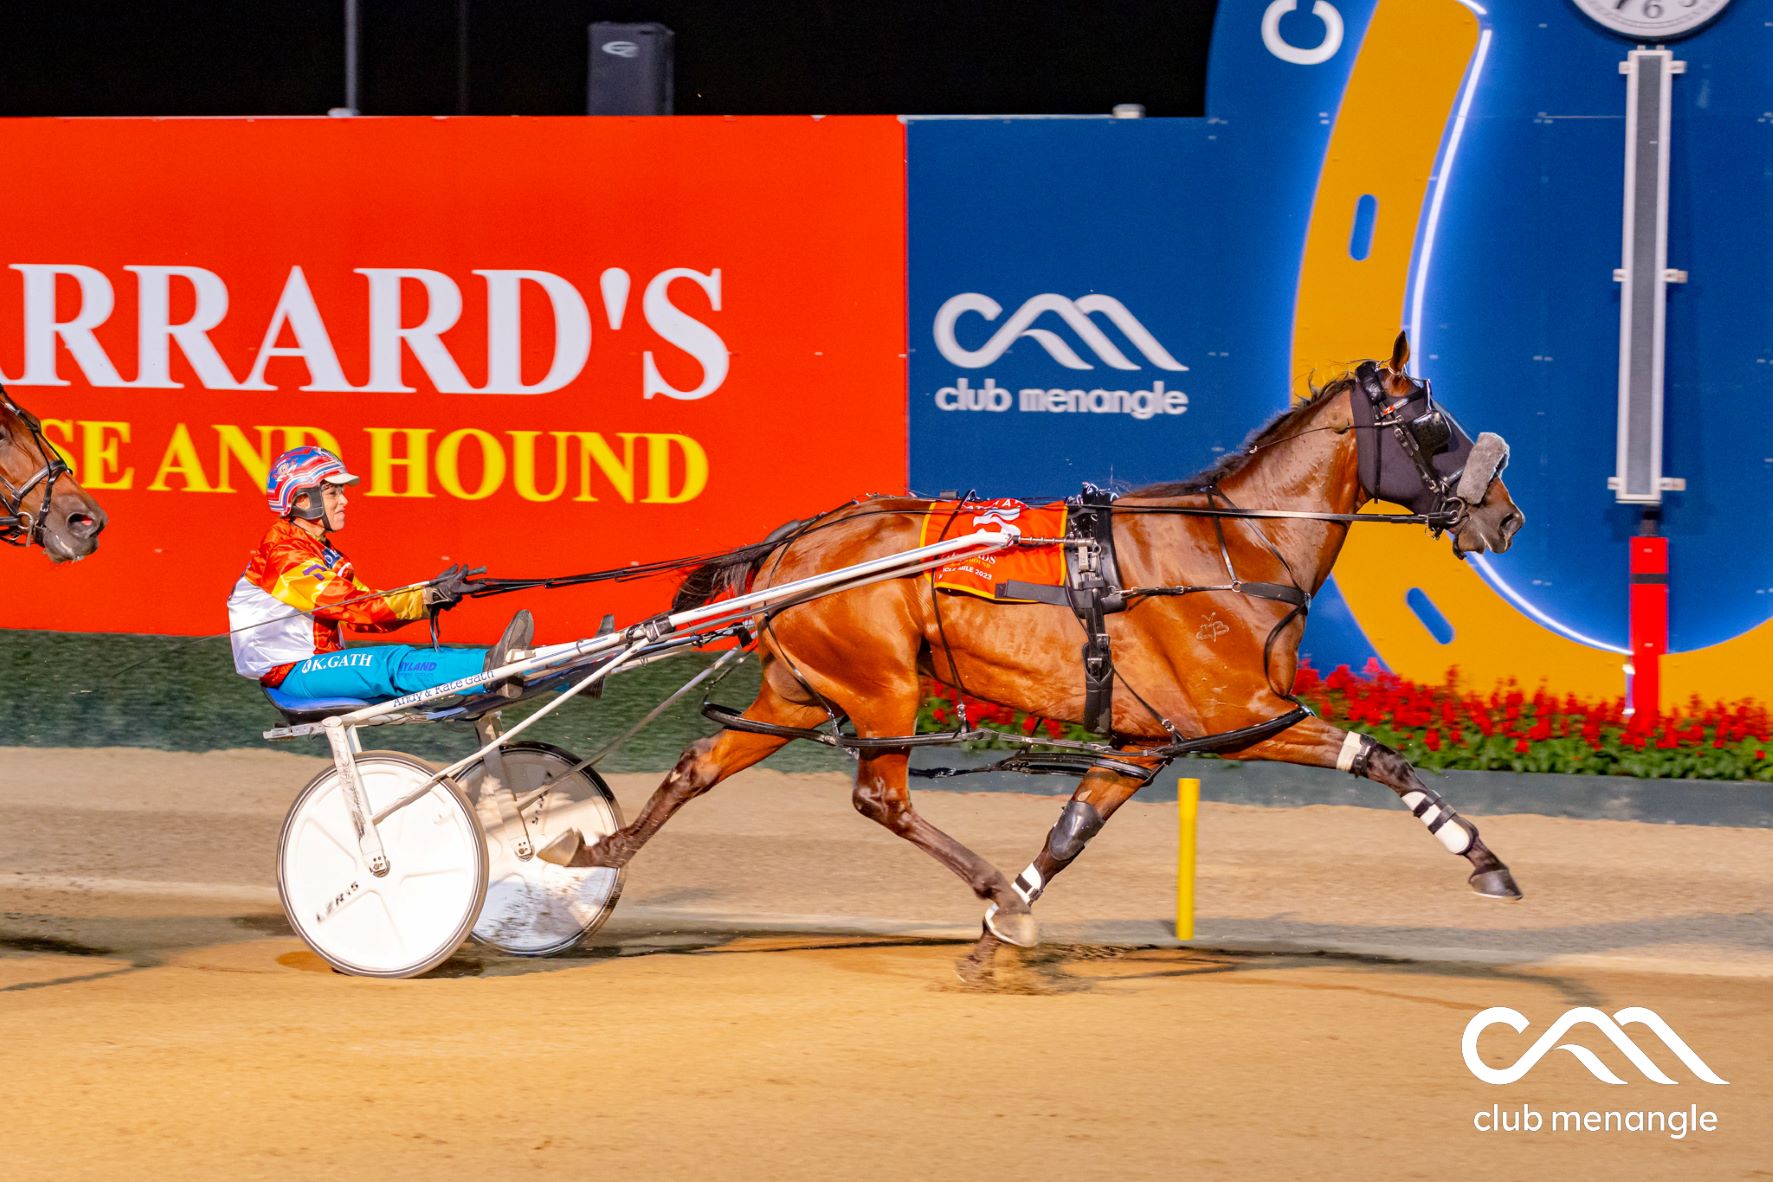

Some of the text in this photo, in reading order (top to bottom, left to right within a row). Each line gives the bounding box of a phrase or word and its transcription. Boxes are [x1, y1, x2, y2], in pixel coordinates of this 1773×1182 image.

[0, 263, 730, 400] RRARD'S
[934, 378, 1189, 420] club menangle
[364, 428, 709, 504] HOUND
[393, 691, 422, 708] Andy
[435, 678, 463, 695] Kate
[465, 669, 494, 686] Gath
